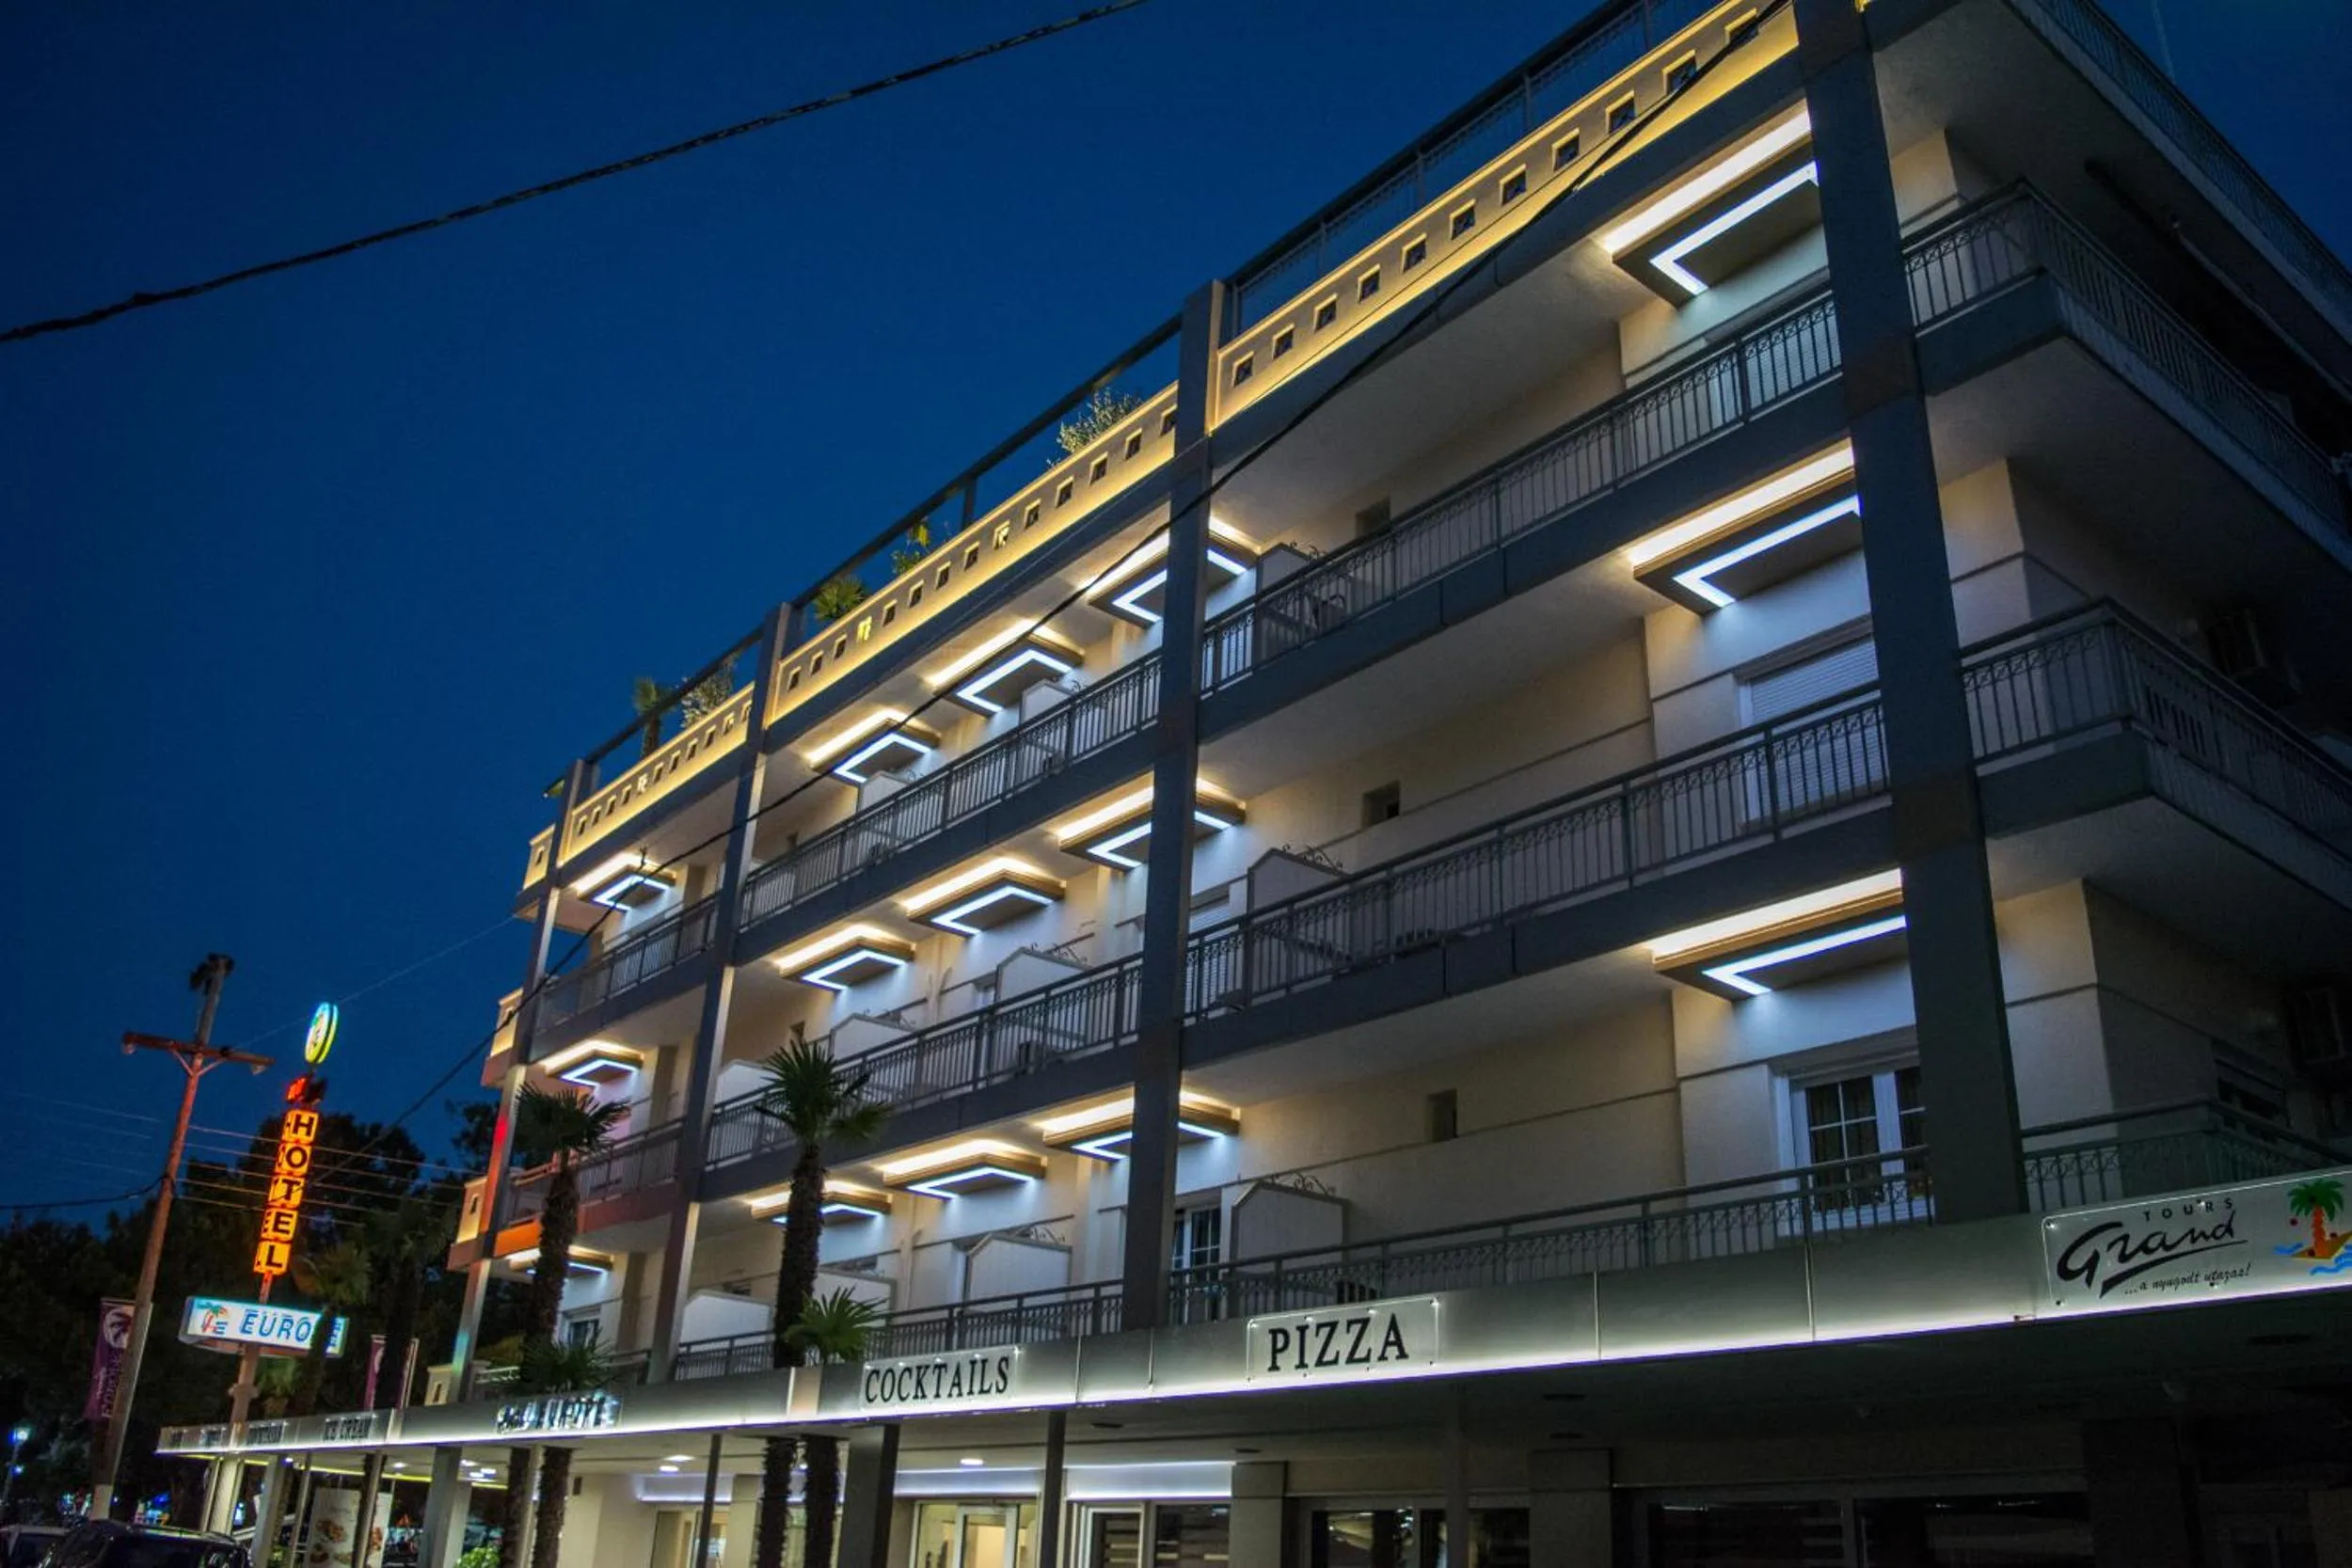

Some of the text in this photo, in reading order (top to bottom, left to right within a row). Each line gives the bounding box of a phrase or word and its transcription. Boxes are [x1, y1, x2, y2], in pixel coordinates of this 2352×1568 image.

[265, 1114, 314, 1269] HOTEL
[2143, 1197, 2233, 1222] TOURS
[2057, 1210, 2236, 1290] Grand
[240, 1308, 312, 1342] EURO
[1267, 1313, 1409, 1371] PIZZA
[865, 1356, 1010, 1403] COCKTAILS
